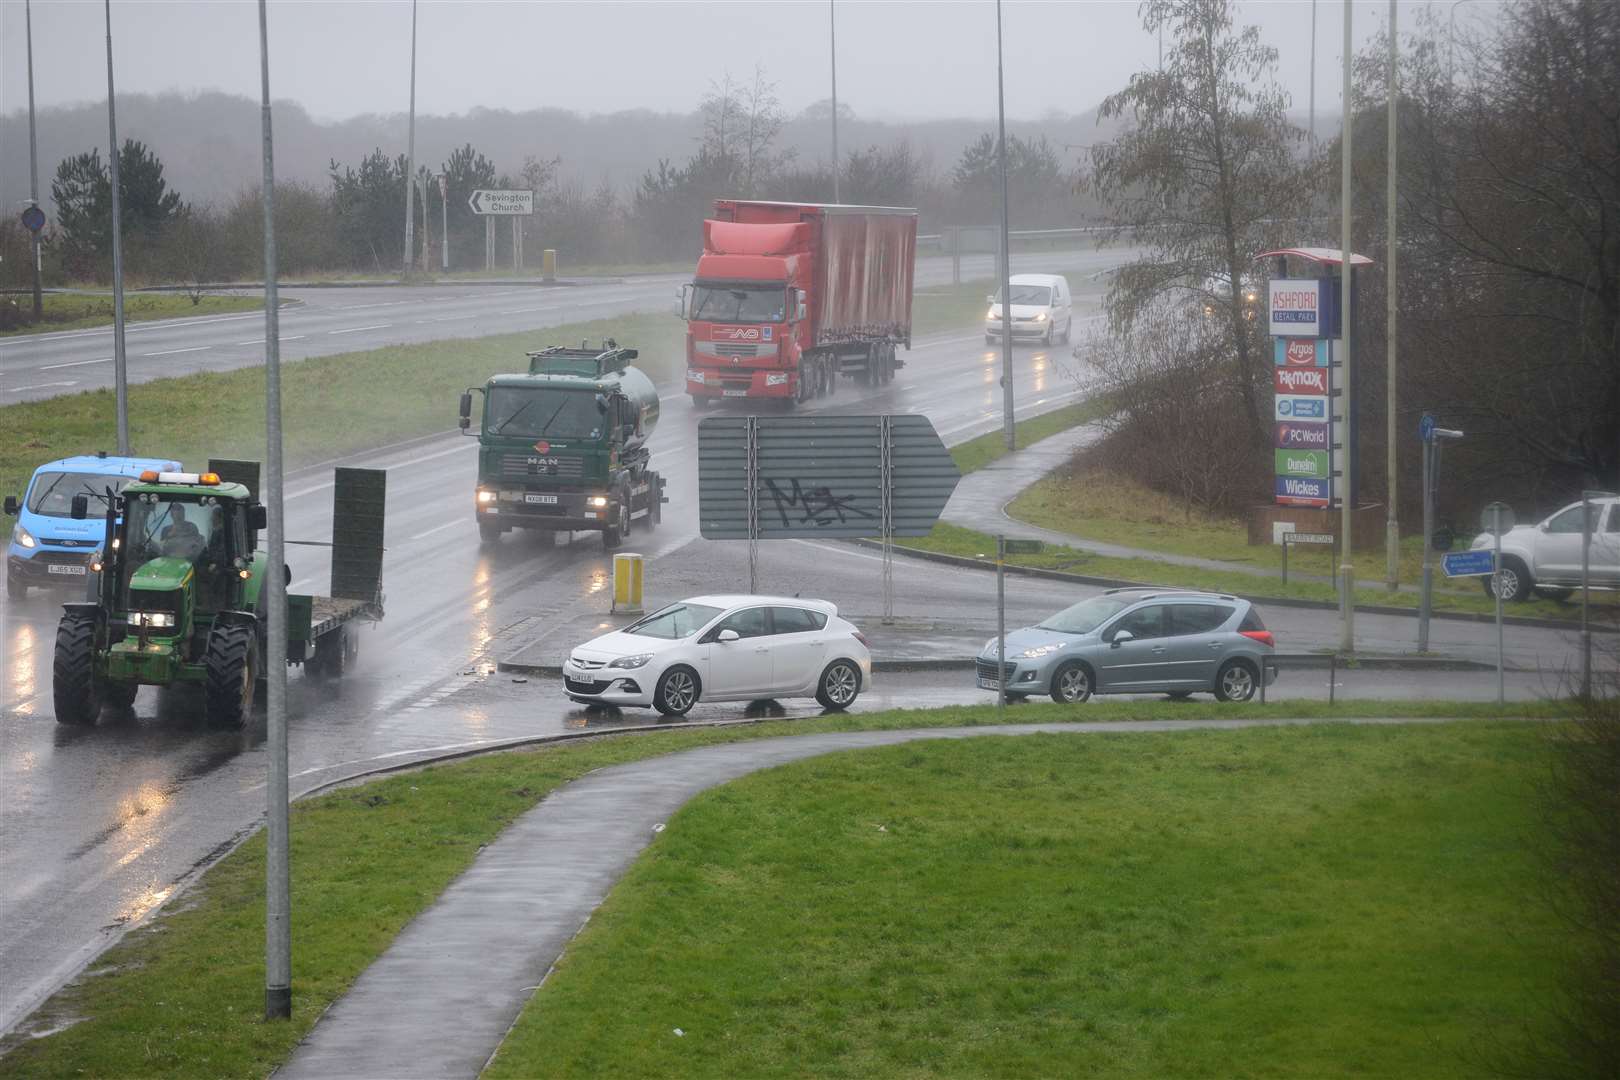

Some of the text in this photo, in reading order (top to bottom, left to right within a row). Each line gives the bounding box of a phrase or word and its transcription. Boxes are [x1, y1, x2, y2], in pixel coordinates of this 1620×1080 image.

[485, 193, 530, 202] Sevington
[492, 203, 525, 211] Church
[1273, 291, 1317, 309] ASHFORD
[1274, 312, 1315, 321] RETAIL PARK
[1288, 341, 1313, 358] Argos
[1290, 430, 1324, 442] PC World
[1287, 457, 1315, 471] Dunelm
[1285, 479, 1320, 496] Wickes
